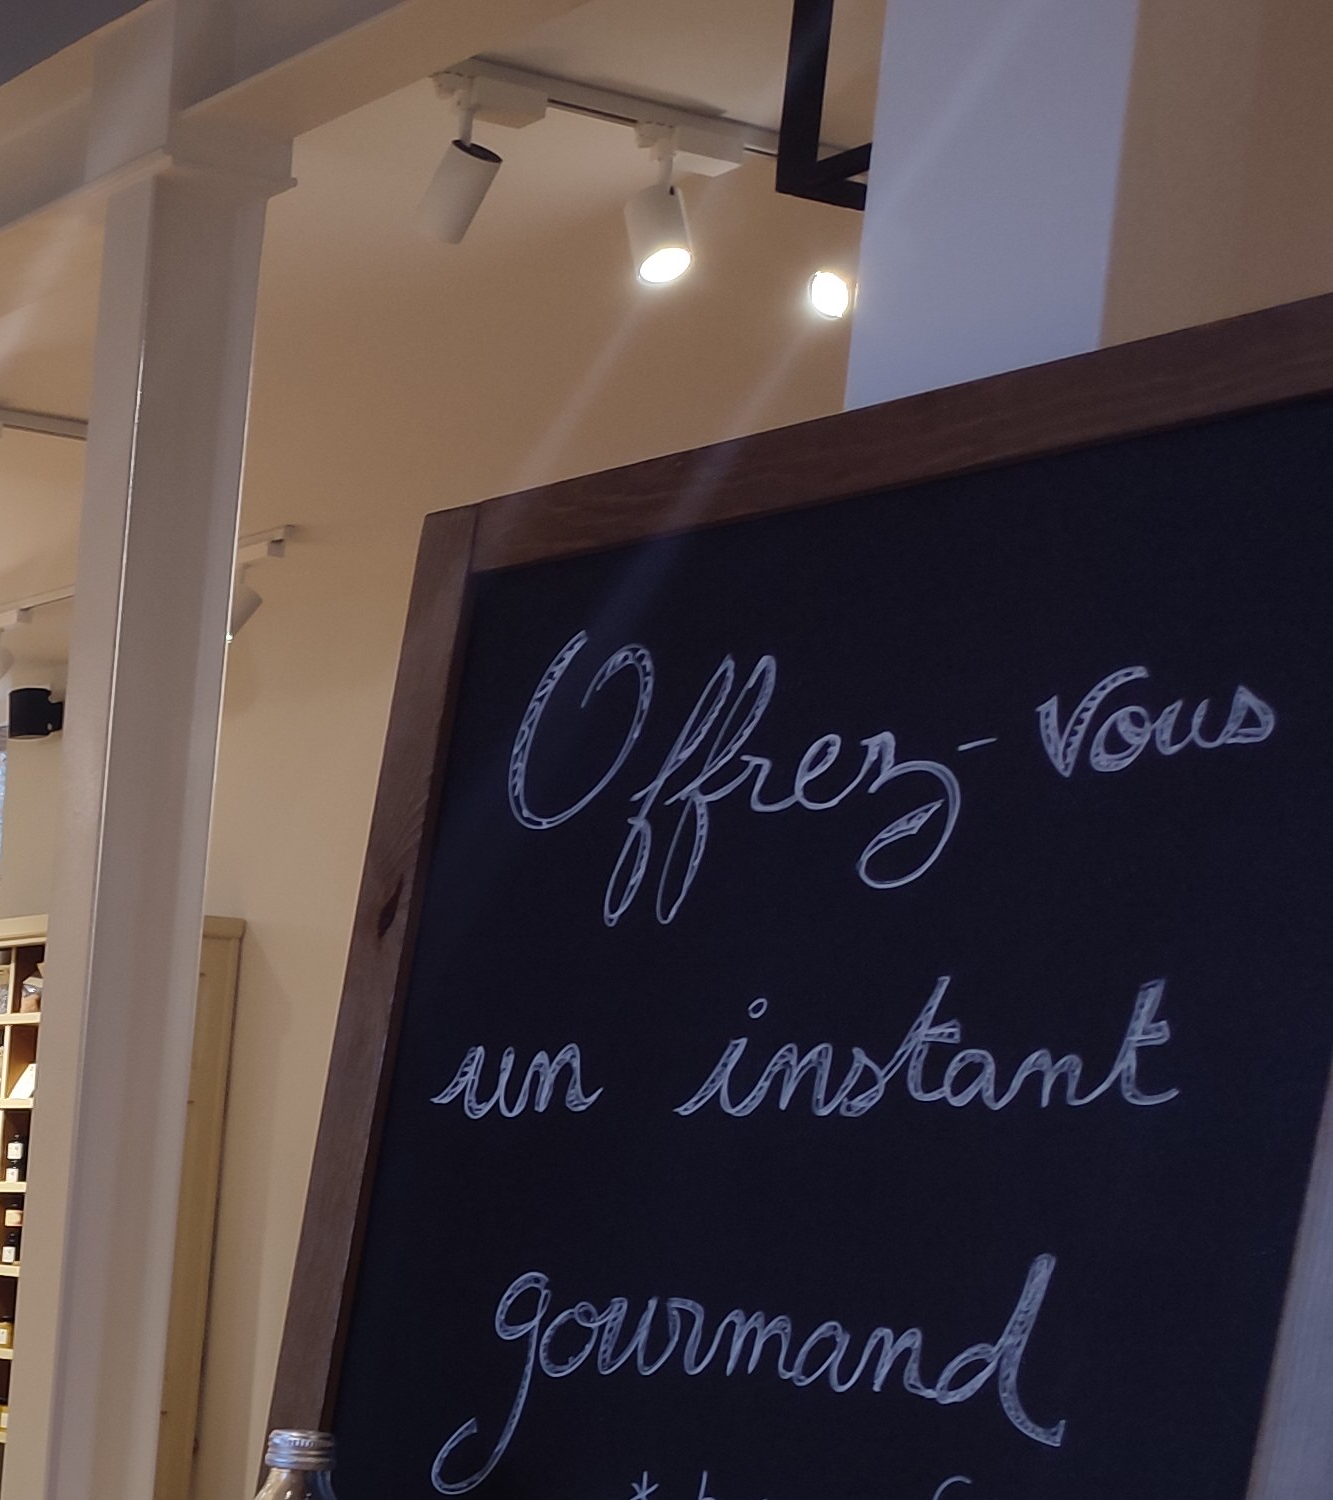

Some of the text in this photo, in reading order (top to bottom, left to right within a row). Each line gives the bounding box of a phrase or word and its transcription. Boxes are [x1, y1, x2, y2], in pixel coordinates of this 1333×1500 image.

[430, 976, 1180, 1119] un instant
[430, 1254, 1066, 1495] gourmand
